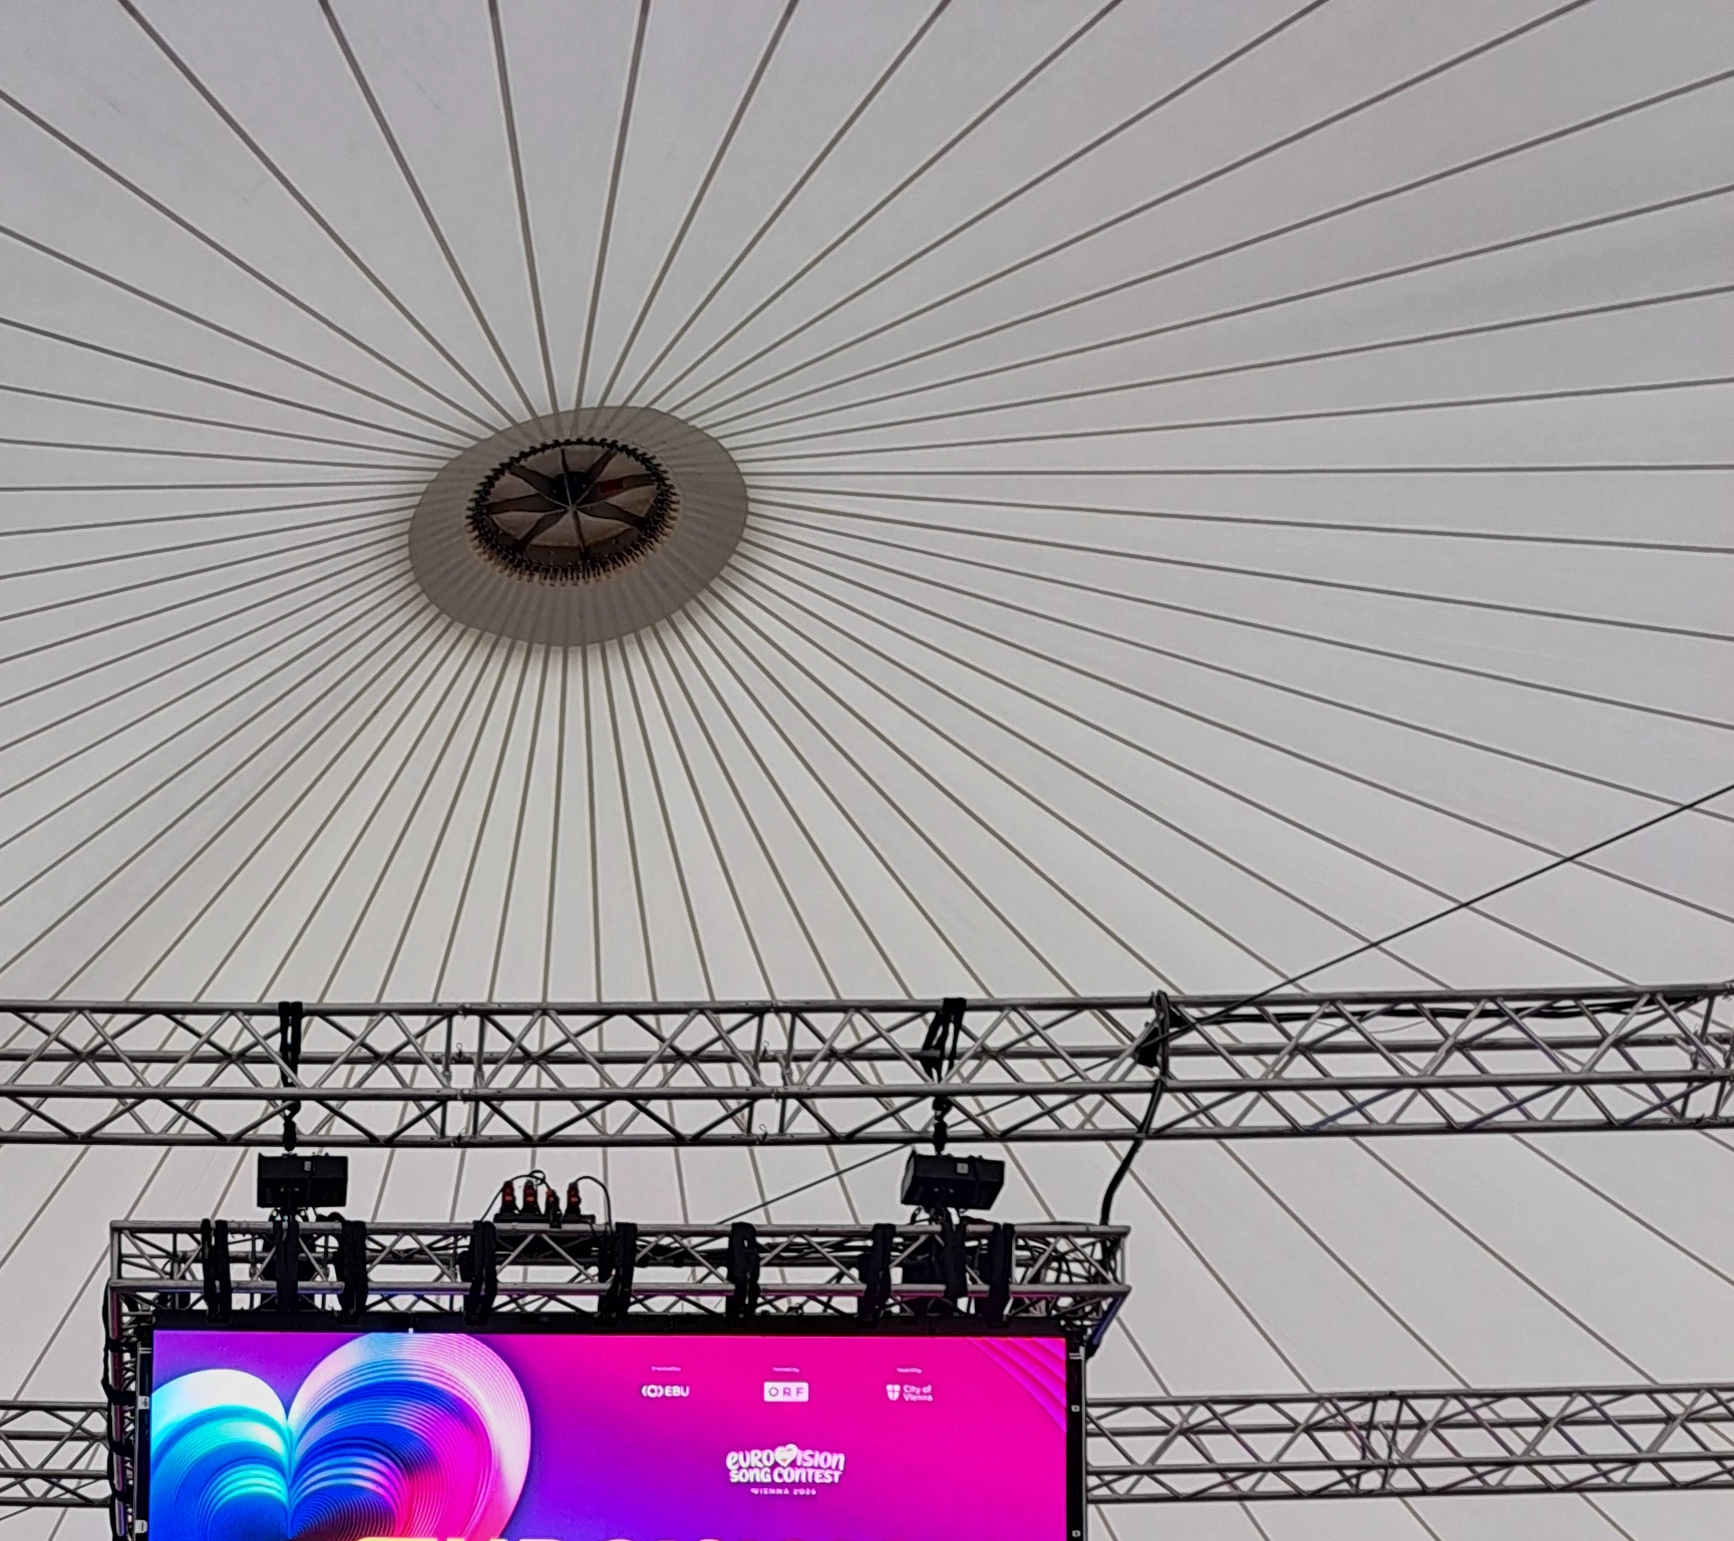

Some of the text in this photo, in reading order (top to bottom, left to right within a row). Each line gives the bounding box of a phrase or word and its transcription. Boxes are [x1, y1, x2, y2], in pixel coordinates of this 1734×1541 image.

[664, 1385, 690, 1397] EBU
[729, 1467, 843, 1485] SONG CONTEST
